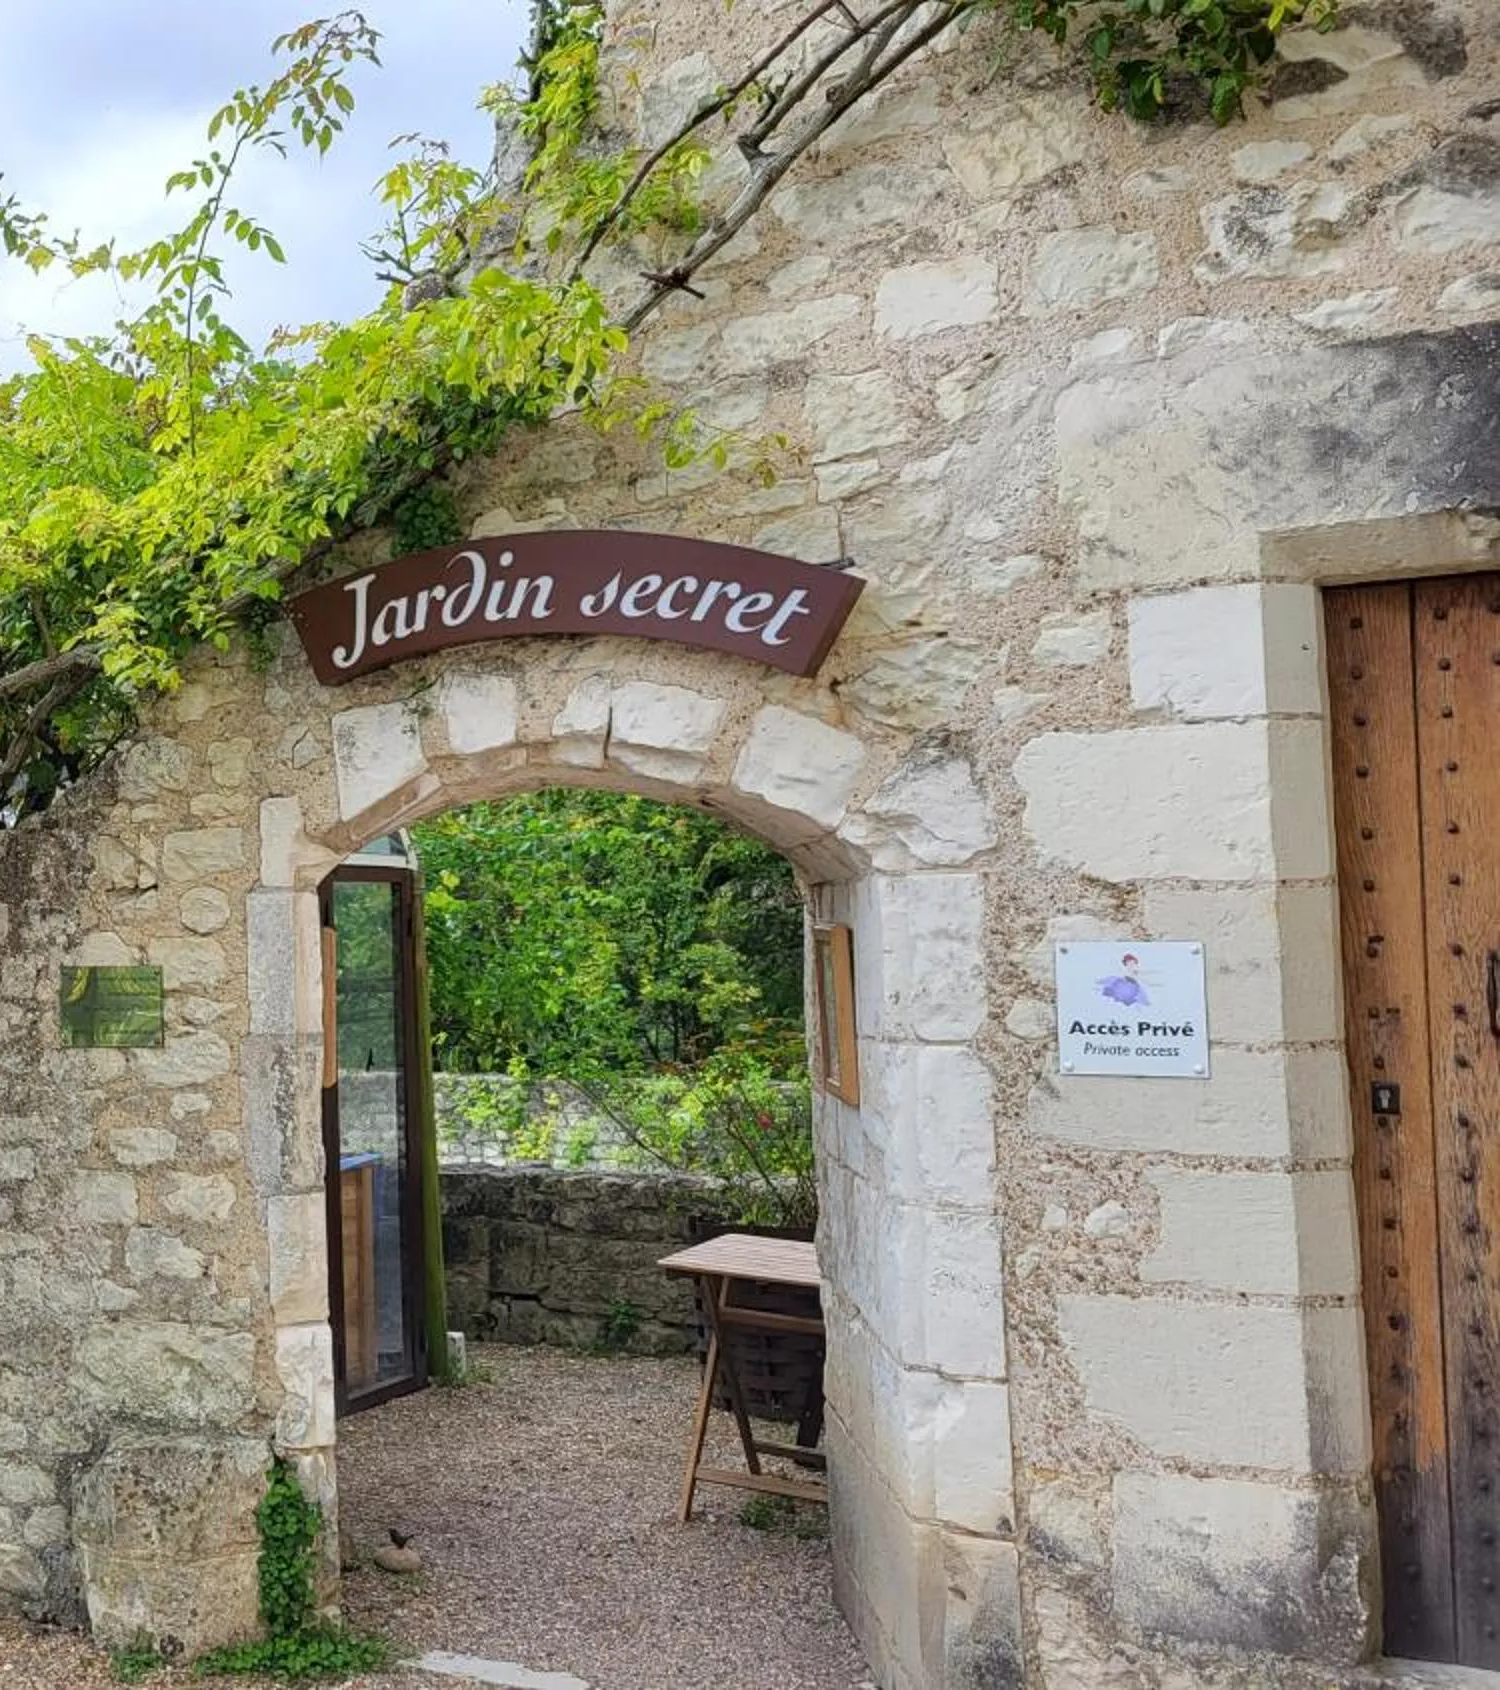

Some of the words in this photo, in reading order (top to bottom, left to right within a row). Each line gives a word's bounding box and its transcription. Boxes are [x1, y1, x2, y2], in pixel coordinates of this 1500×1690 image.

[331, 551, 556, 668] Jardin
[579, 566, 811, 646] secret
[1068, 1019, 1131, 1036] Accès
[1137, 1021, 1195, 1037] Privé
[1083, 1042, 1131, 1056] Private
[1135, 1045, 1181, 1057] access
